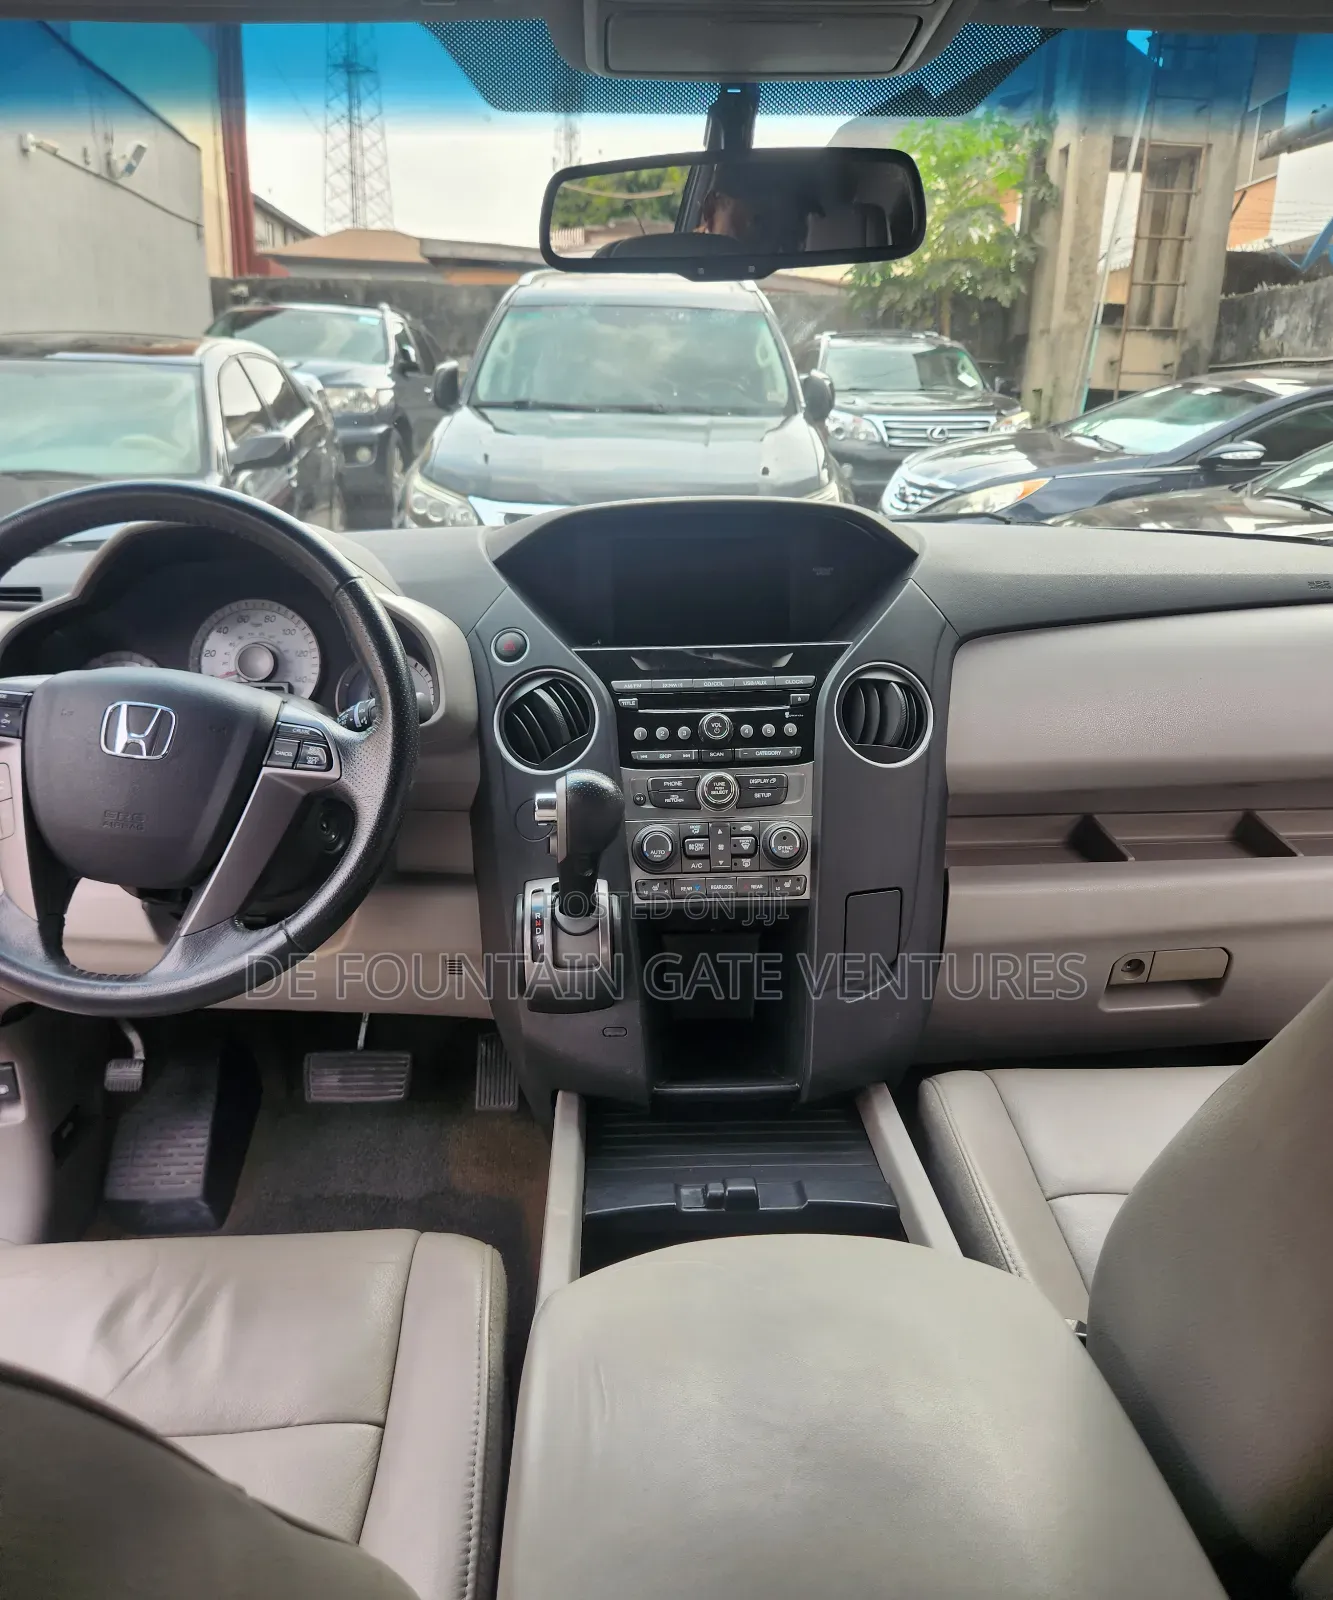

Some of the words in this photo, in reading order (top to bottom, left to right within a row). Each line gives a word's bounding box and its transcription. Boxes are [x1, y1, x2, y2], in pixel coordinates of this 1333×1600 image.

[264, 614, 276, 622] 80
[216, 626, 229, 634] 40
[282, 628, 297, 636] 100
